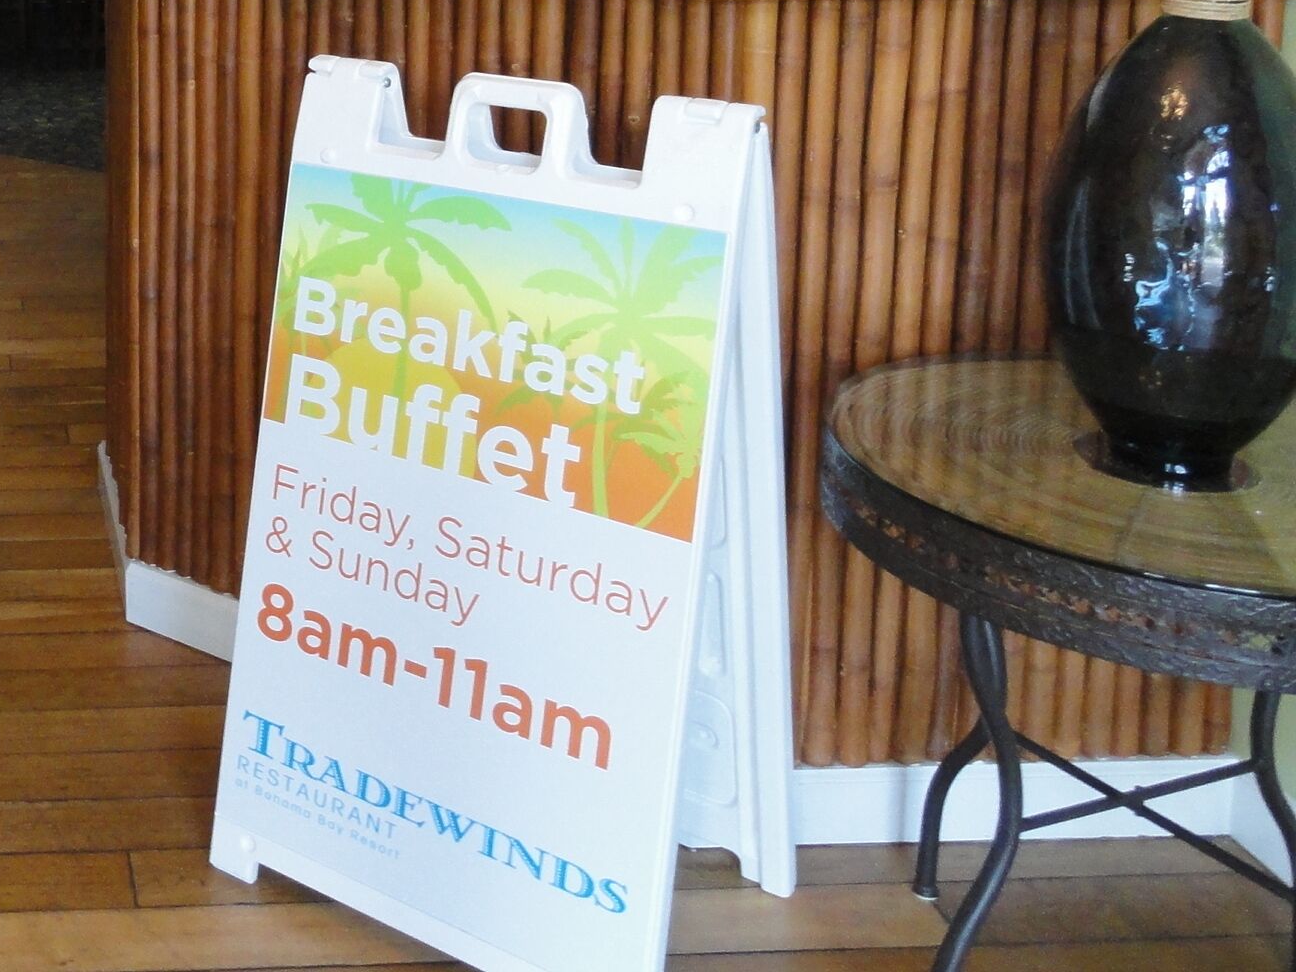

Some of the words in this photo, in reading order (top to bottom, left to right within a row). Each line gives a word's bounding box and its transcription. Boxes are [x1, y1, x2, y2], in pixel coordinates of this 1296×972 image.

[292, 275, 646, 416] Breakfast
[283, 353, 581, 507] Buffet
[264, 515, 294, 558] &
[308, 530, 481, 627] Sunday
[271, 464, 416, 551] Friday,
[434, 516, 670, 632] Saturday
[256, 583, 612, 770] 8am-11am
[236, 754, 398, 839] RESTAURANT
[242, 709, 630, 915] TRADEWINDS
[317, 813, 345, 836] Bay
[350, 828, 402, 860] Resort
